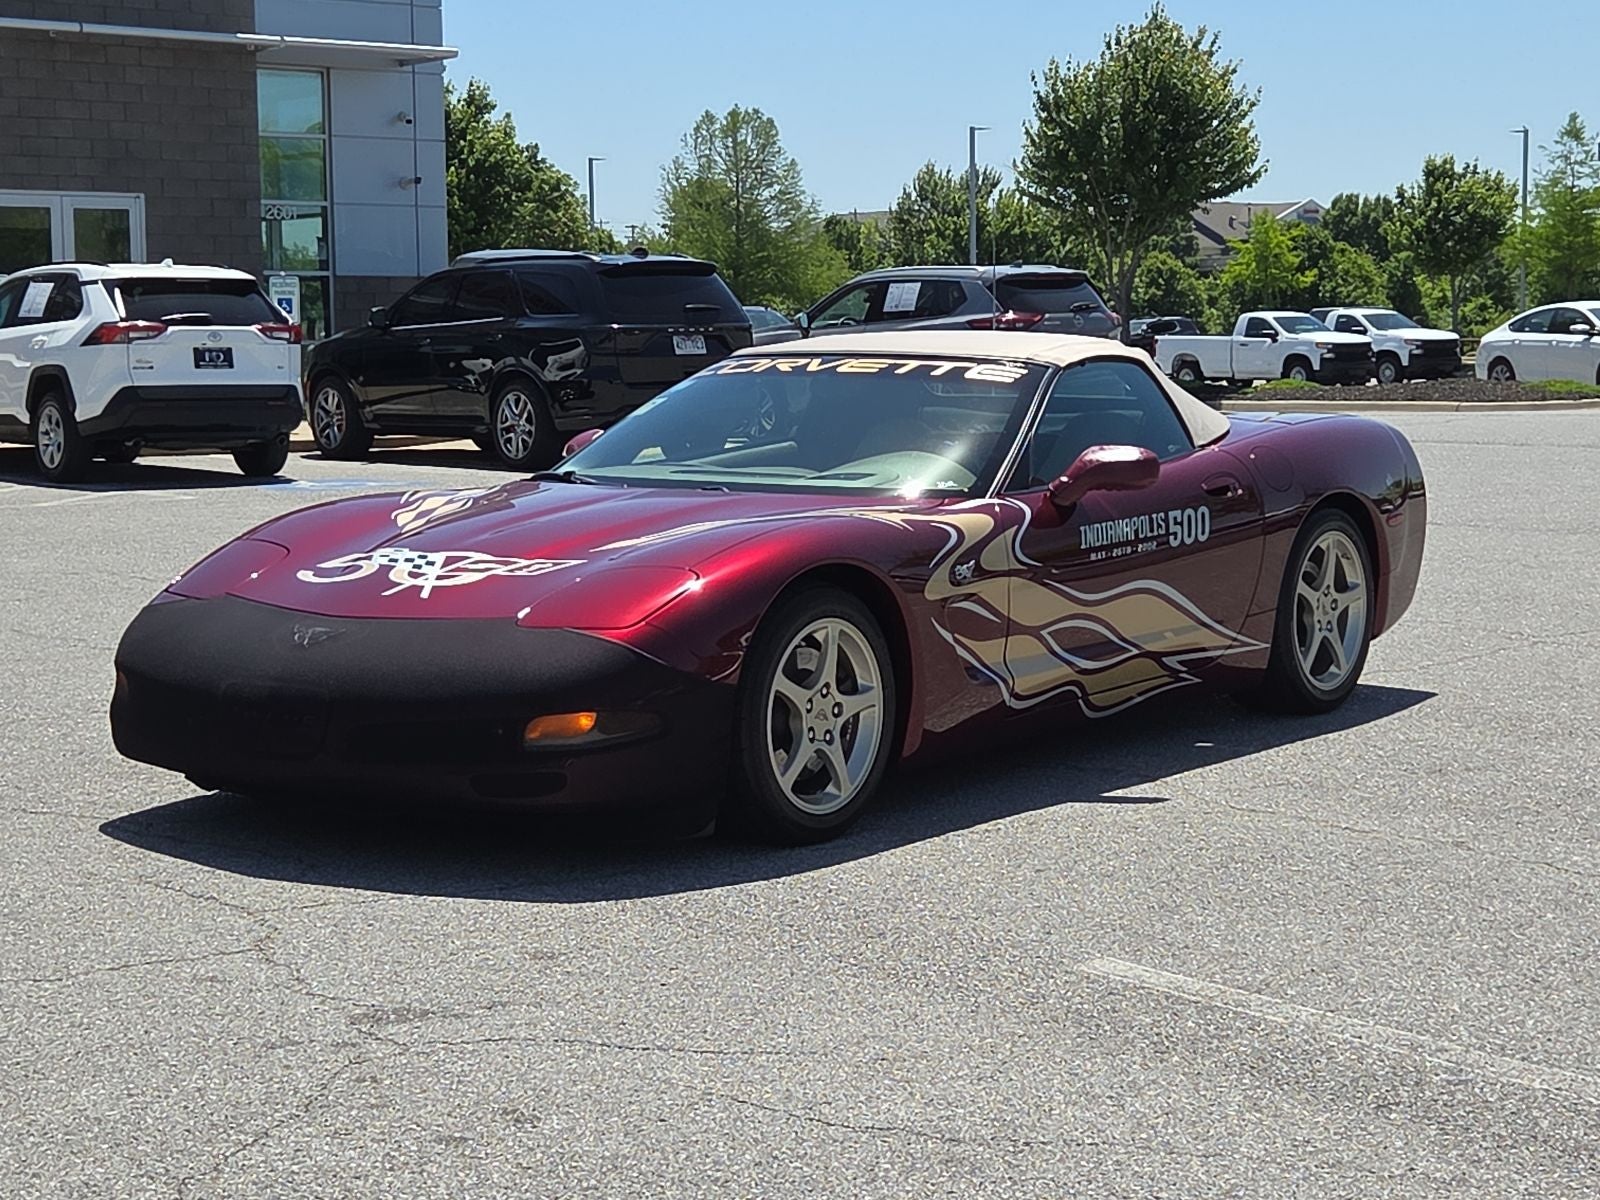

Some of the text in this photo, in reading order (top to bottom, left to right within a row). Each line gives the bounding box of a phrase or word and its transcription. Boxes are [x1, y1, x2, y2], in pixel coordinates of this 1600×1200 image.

[265, 204, 298, 220] 2601
[1079, 505, 1211, 549] INDIANAPOLIS 500
